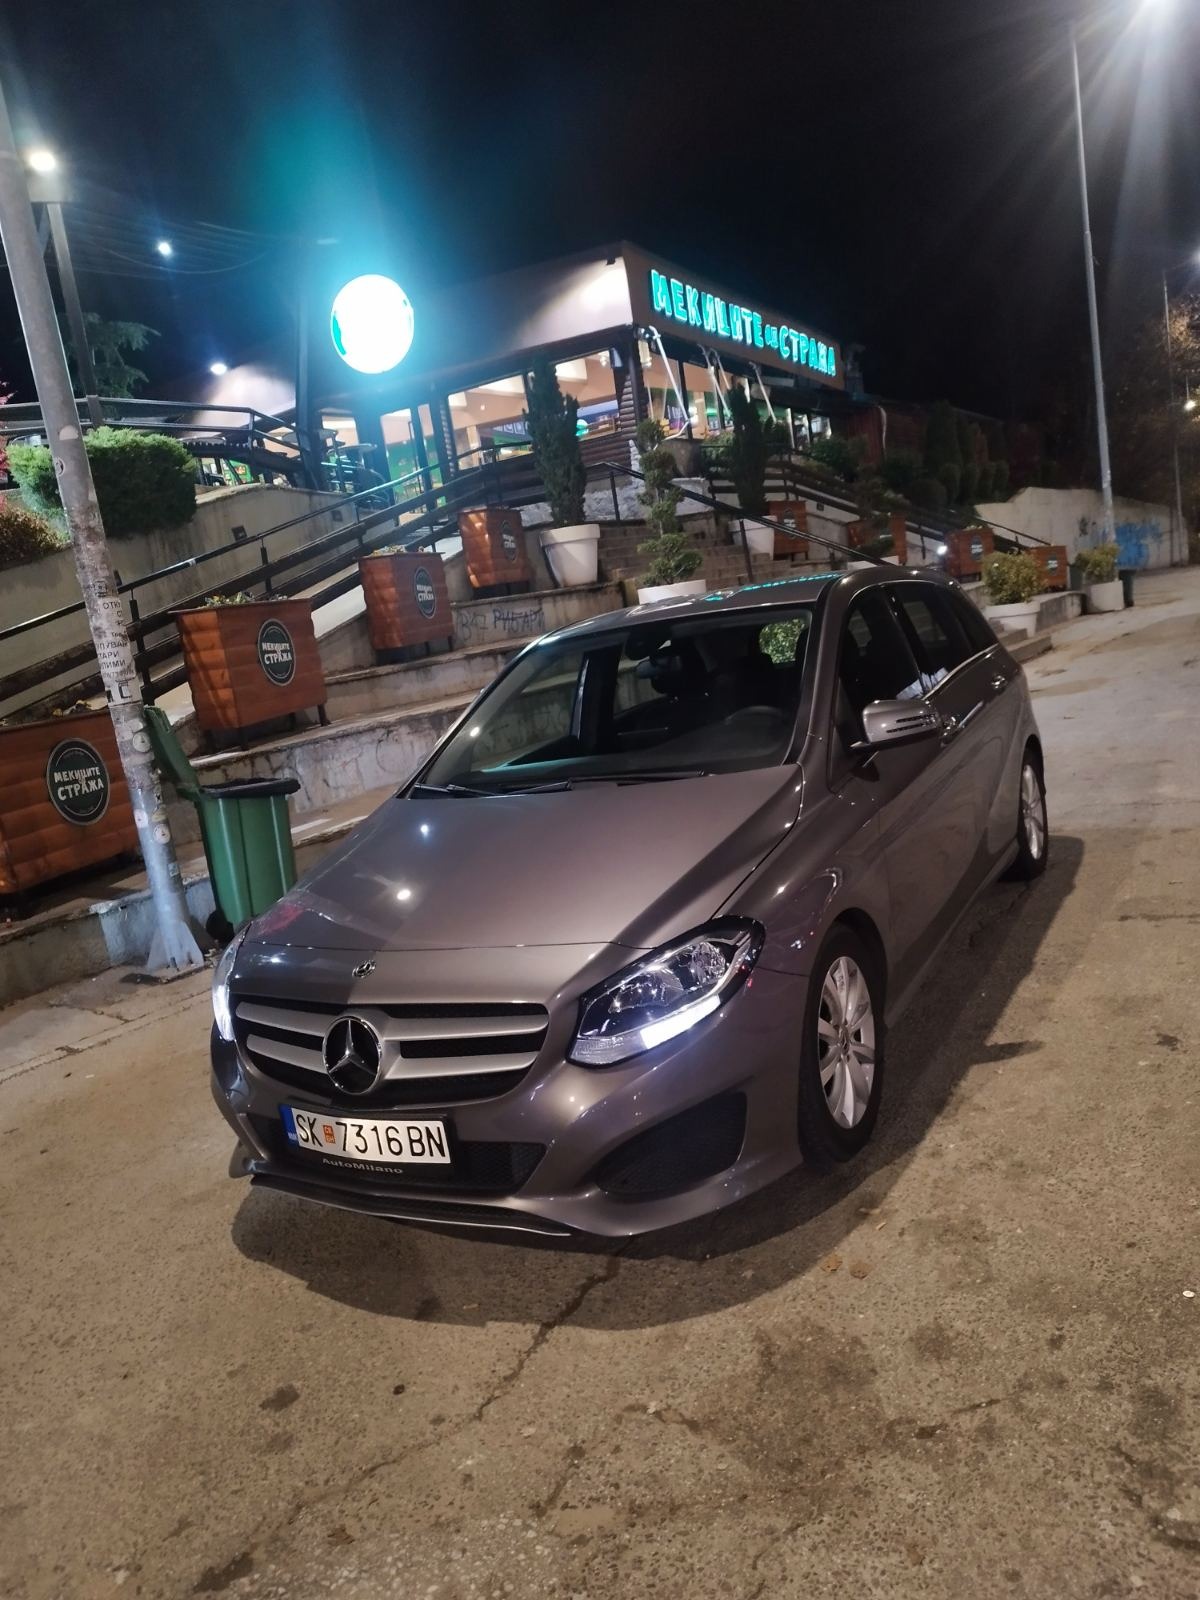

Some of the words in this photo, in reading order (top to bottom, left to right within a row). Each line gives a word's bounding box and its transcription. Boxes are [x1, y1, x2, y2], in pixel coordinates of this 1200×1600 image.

[650, 269, 764, 348] МЕКИЦИТЕ
[779, 325, 837, 377] СТРАЖА
[264, 652, 293, 665] СТРАЖА
[53, 767, 100, 783] МЕКИЦИТЕ
[57, 778, 104, 801] СТРАЖА
[296, 1114, 323, 1147] SK
[322, 1158, 404, 1174] AutoMilano
